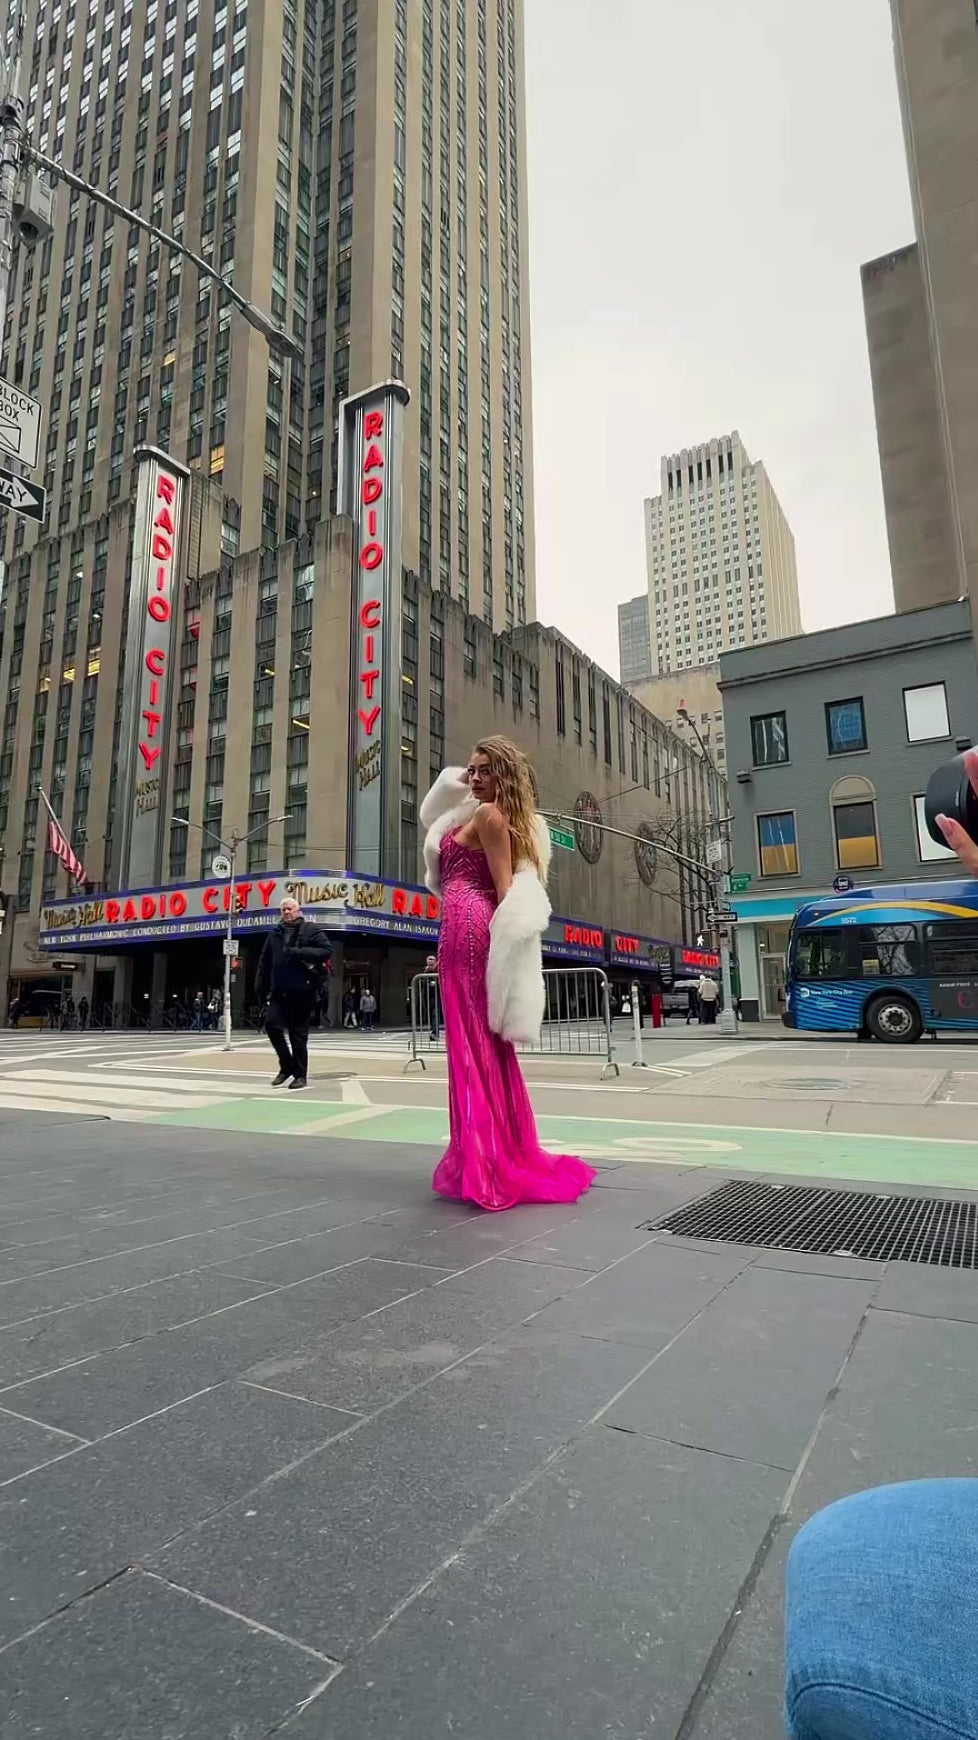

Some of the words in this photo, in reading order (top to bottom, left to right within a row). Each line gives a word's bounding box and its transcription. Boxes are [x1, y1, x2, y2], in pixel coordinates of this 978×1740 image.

[359, 411, 384, 570] RADIO
[148, 474, 175, 622] RADIO
[357, 600, 381, 735] CITY
[138, 648, 166, 771] CITY
[104, 889, 188, 924] RADIO
[202, 878, 278, 914] CITY
[284, 881, 349, 905] Music
[343, 882, 385, 909] Hall
[132, 924, 176, 937] CONDUCTED
[237, 915, 279, 927] DUDAMEL
[353, 916, 390, 930] GREGORY
[394, 922, 413, 932] ALAN
[565, 924, 603, 949] RADIO
[616, 935, 639, 953] CITY
